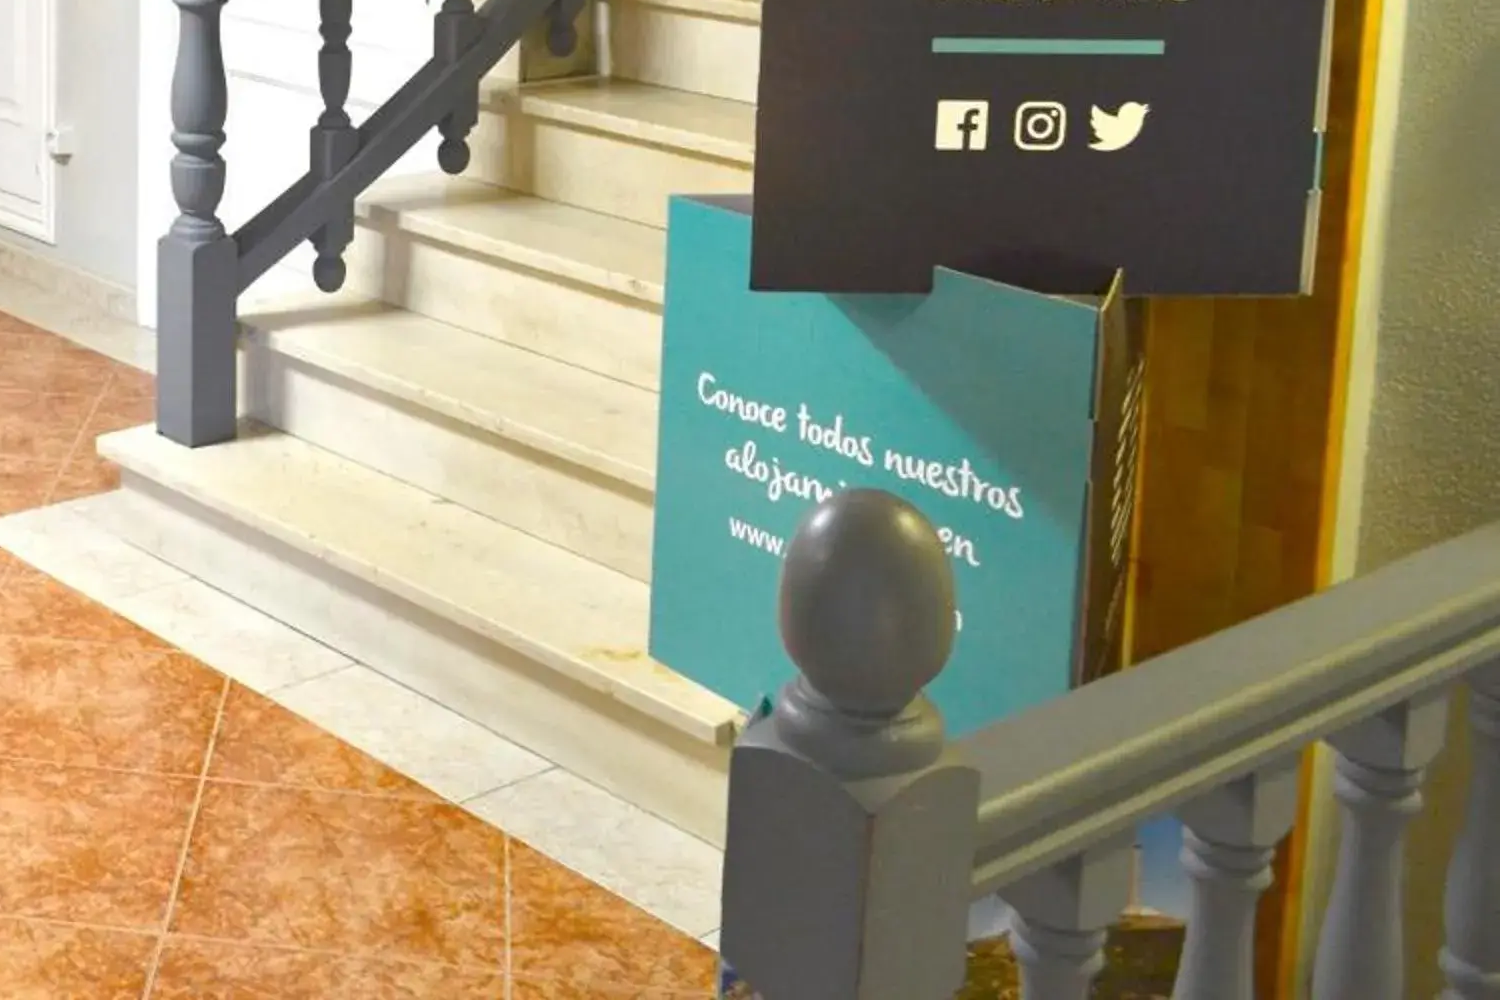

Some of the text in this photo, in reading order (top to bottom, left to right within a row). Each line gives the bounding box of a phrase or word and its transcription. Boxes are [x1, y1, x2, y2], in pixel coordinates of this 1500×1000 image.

[697, 372, 1023, 519] Conoce todos nuestros
